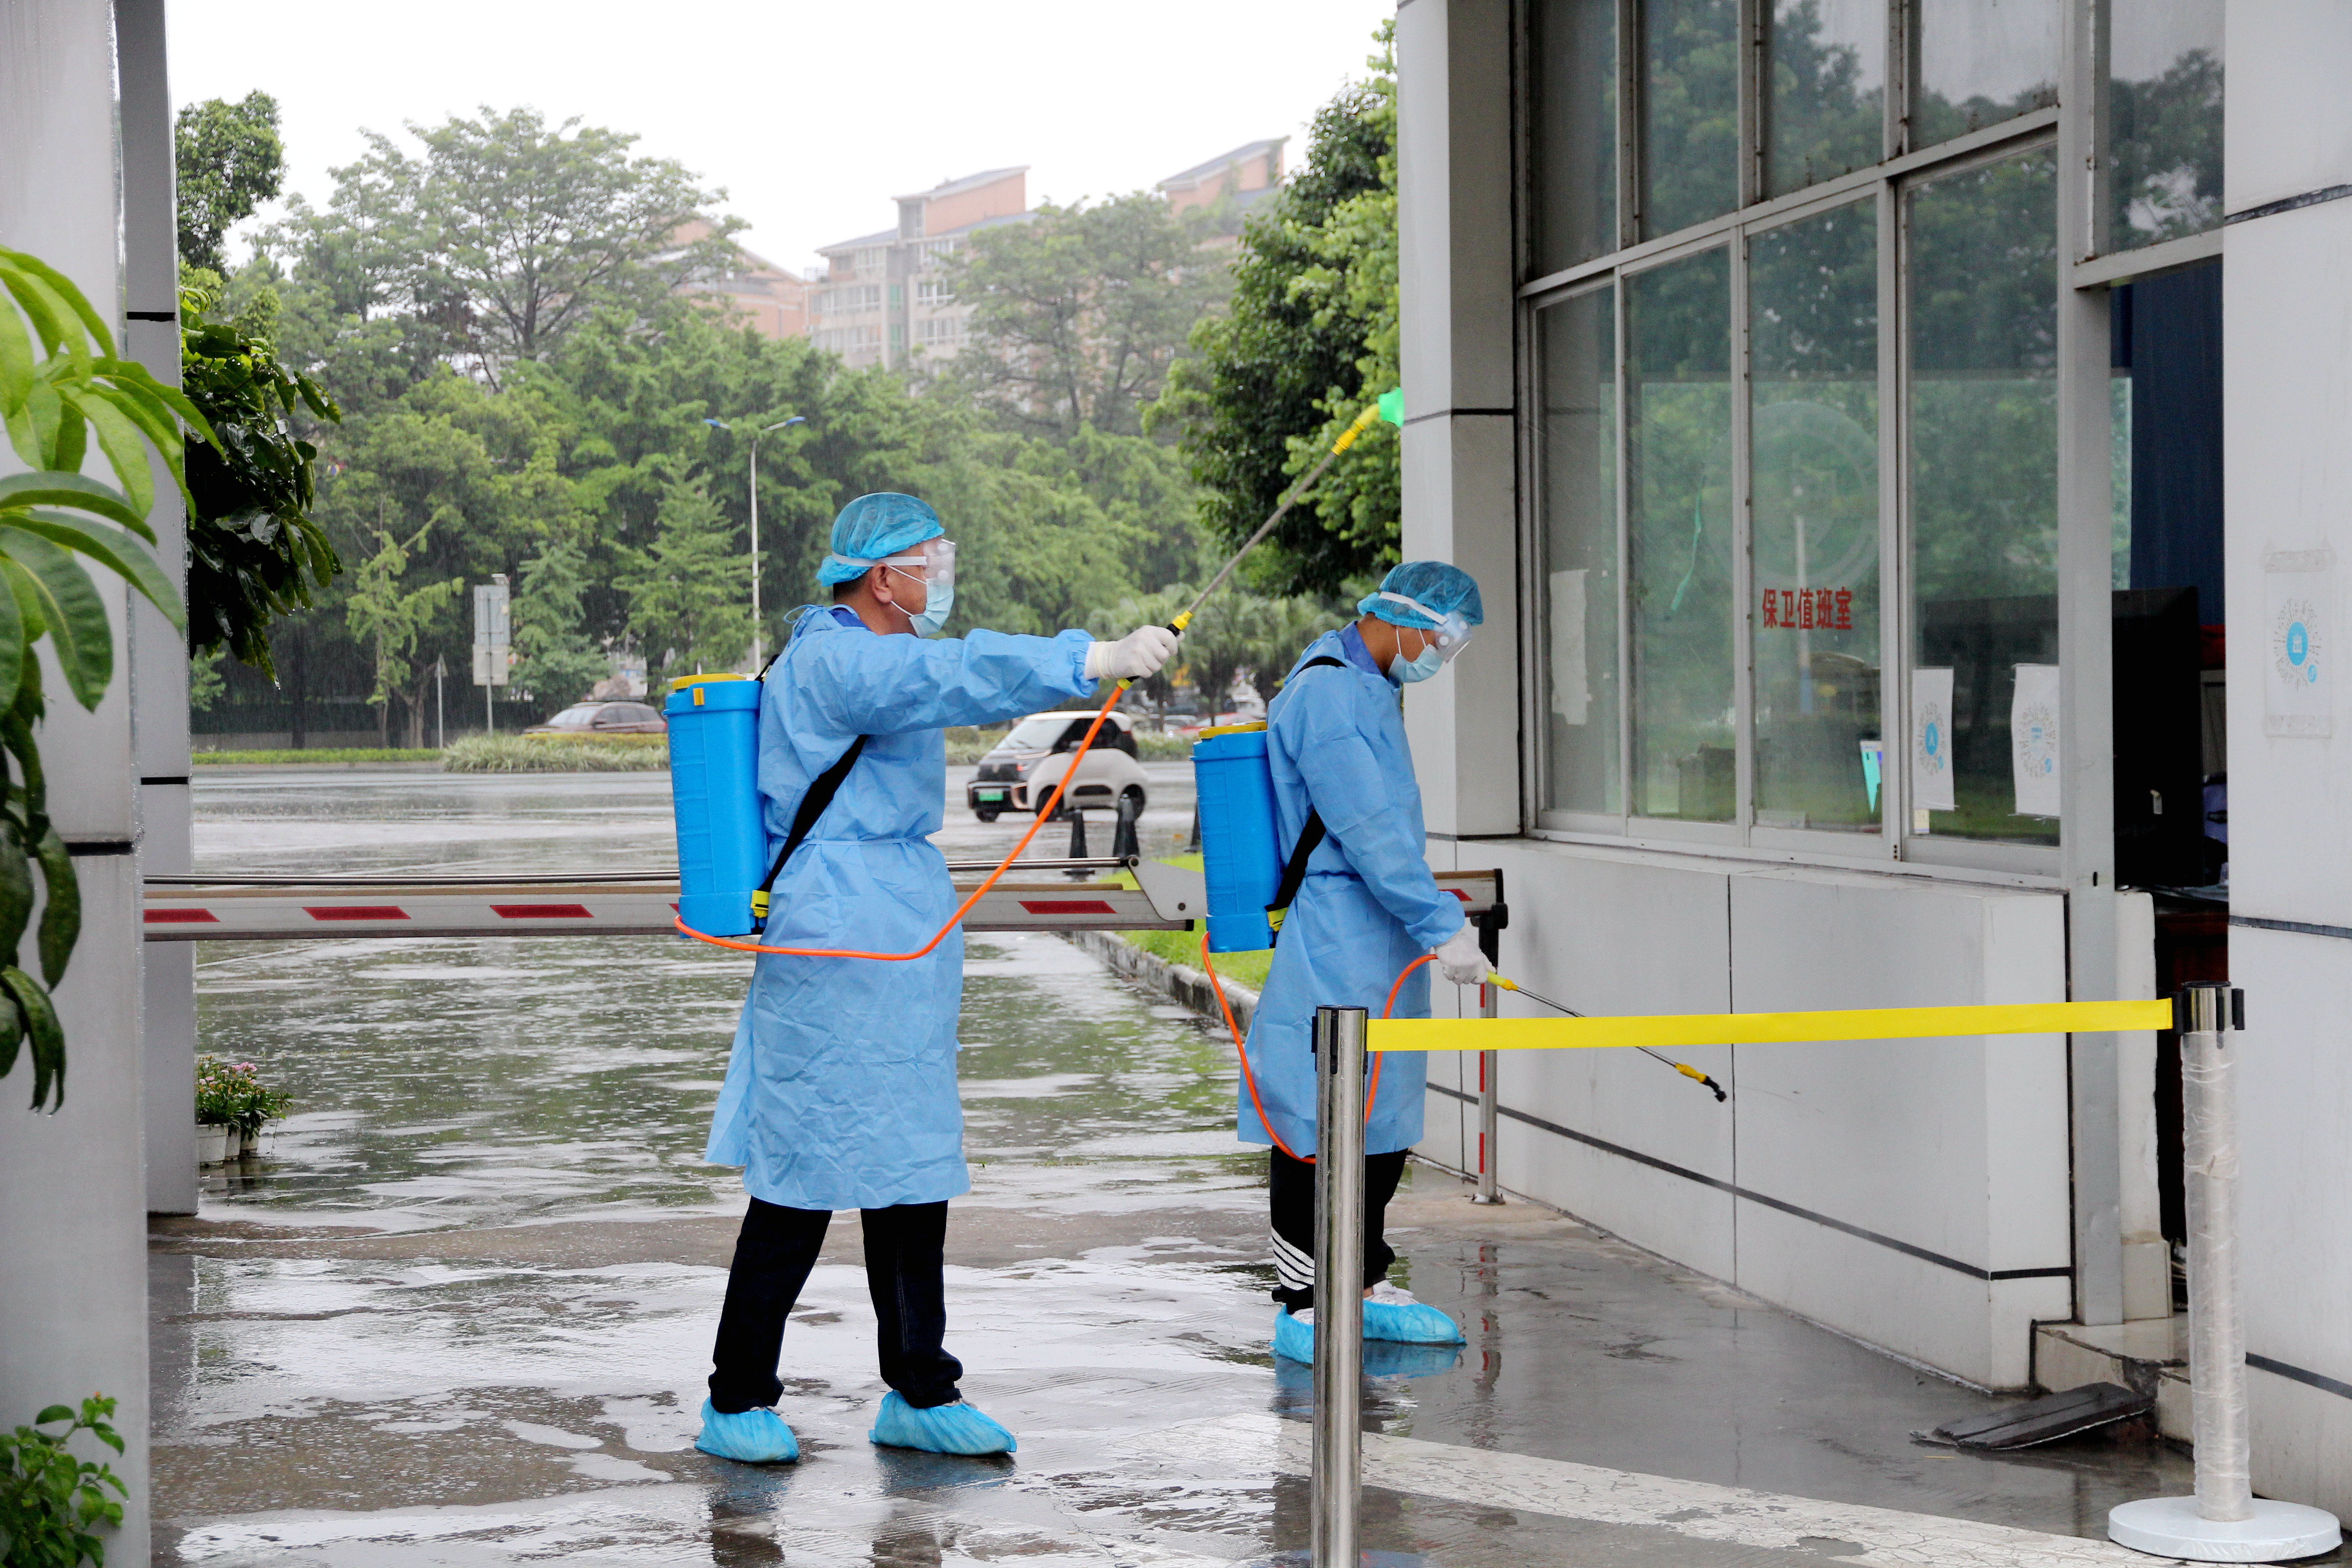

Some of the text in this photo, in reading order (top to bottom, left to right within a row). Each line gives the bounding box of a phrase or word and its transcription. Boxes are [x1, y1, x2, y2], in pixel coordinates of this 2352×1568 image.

[1762, 587, 1852, 630] 保卫值班室
